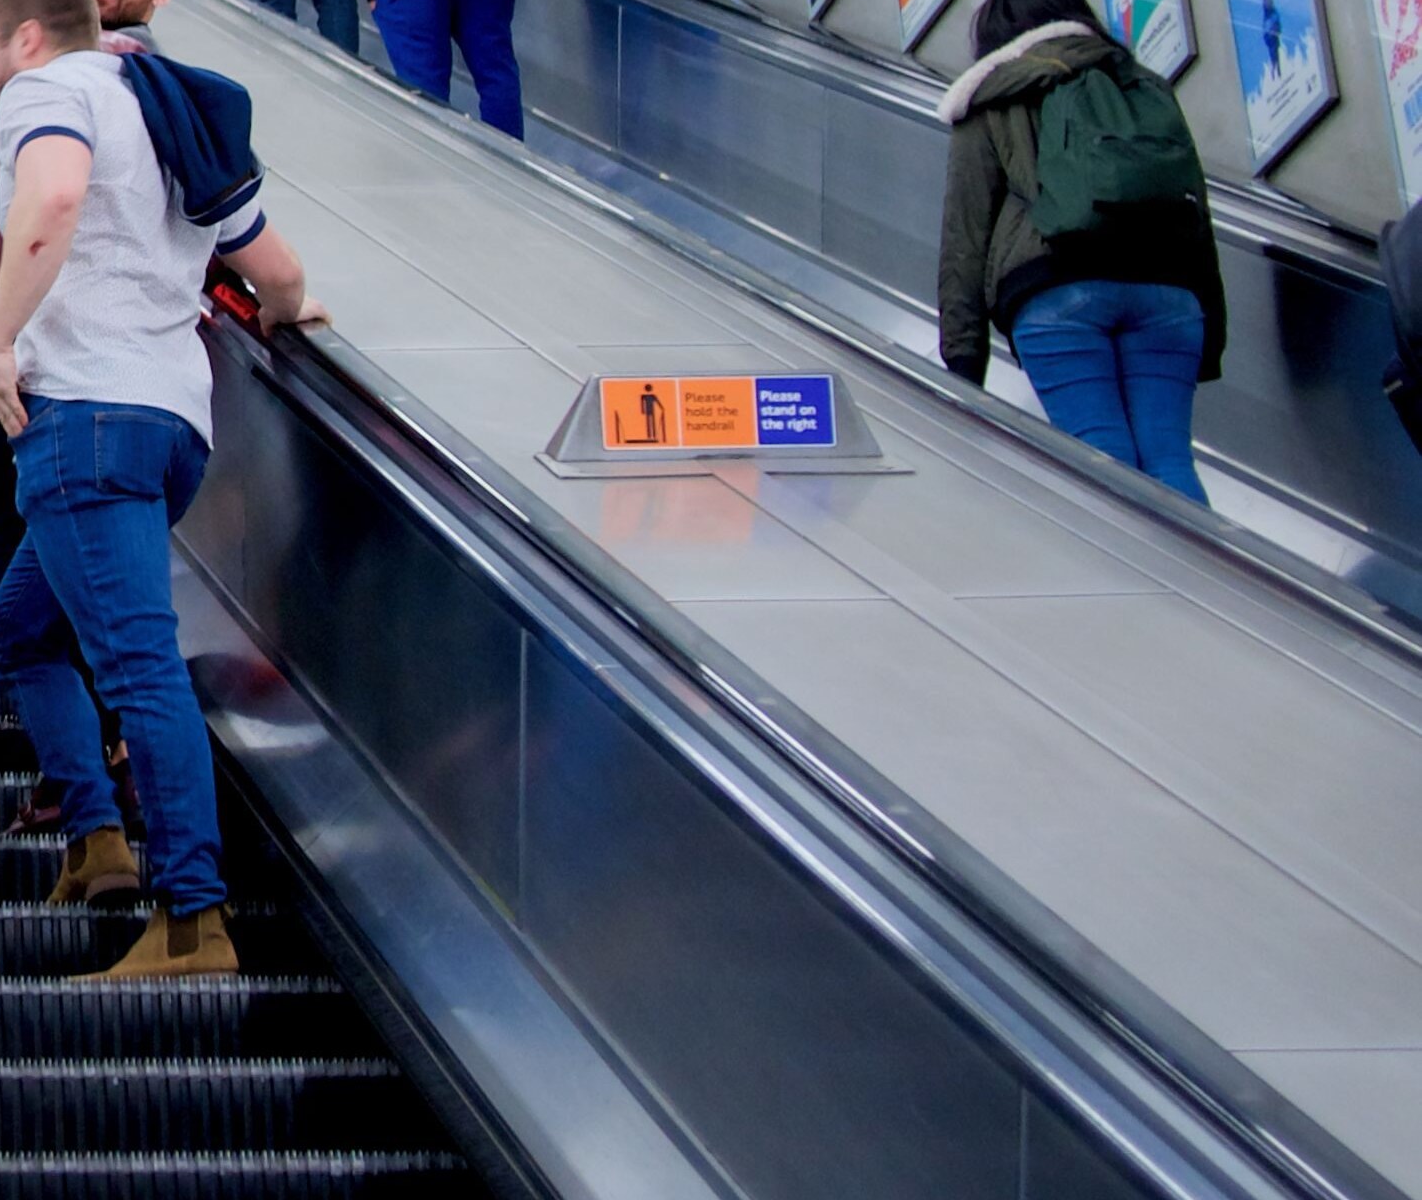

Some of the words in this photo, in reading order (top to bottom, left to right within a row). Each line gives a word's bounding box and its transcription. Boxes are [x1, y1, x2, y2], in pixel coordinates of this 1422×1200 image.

[685, 392, 725, 402] Please
[760, 390, 801, 402] Please
[686, 407, 713, 417] hold
[717, 407, 739, 417] the
[760, 404, 797, 416] stand
[799, 406, 817, 416] on
[686, 421, 735, 431] handrail
[761, 418, 784, 430] the
[786, 418, 818, 433] right
